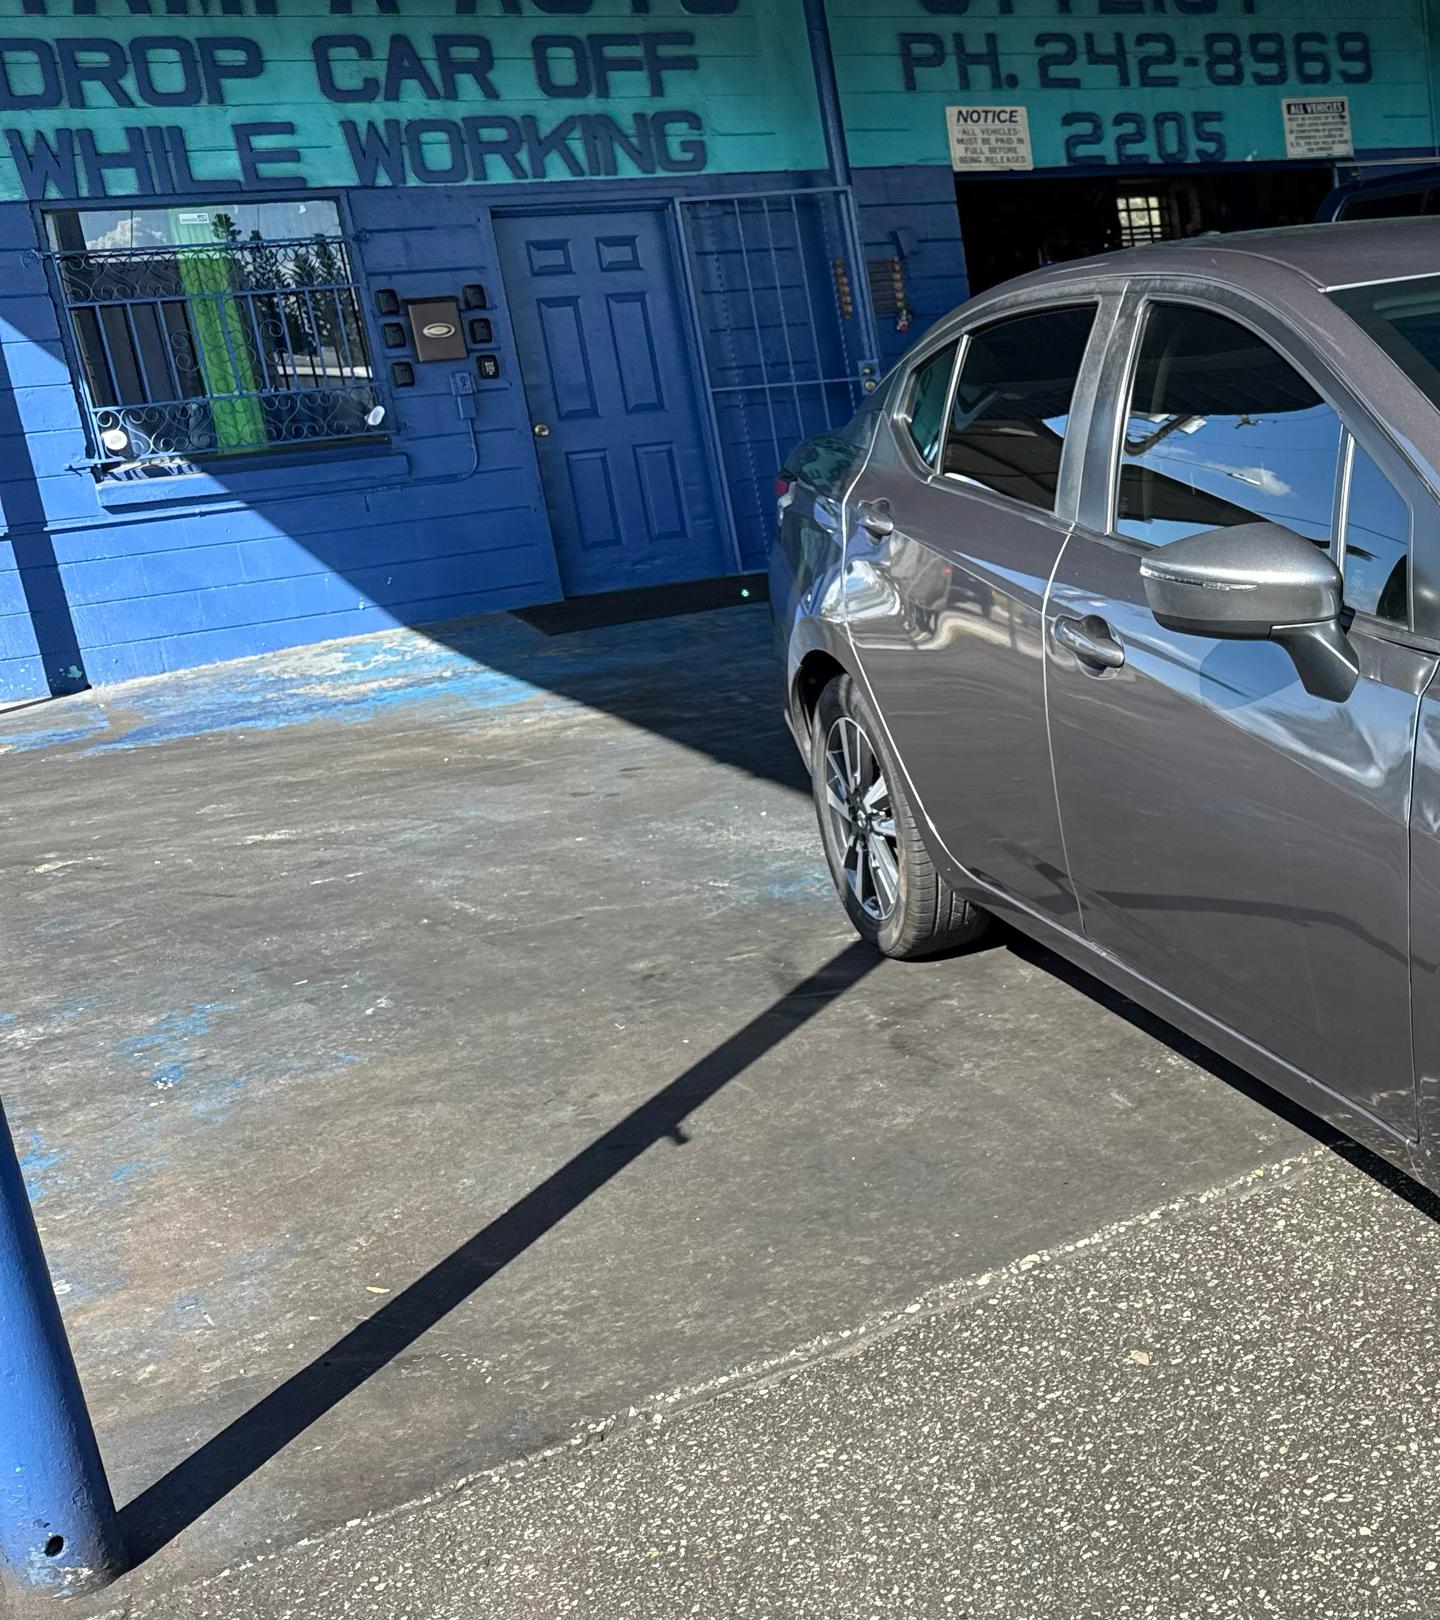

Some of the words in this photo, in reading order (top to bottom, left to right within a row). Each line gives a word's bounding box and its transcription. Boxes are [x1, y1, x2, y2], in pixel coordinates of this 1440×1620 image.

[0, 36, 264, 108] DROP
[312, 34, 501, 101] CAR
[531, 31, 698, 99] OFF
[900, 32, 1020, 91] PH.
[1034, 31, 1374, 89] 242-8969
[956, 110, 1019, 123] NOTICE
[1061, 111, 1229, 165] 2205
[7, 121, 308, 199] WHILE
[341, 111, 709, 187] WORKING
